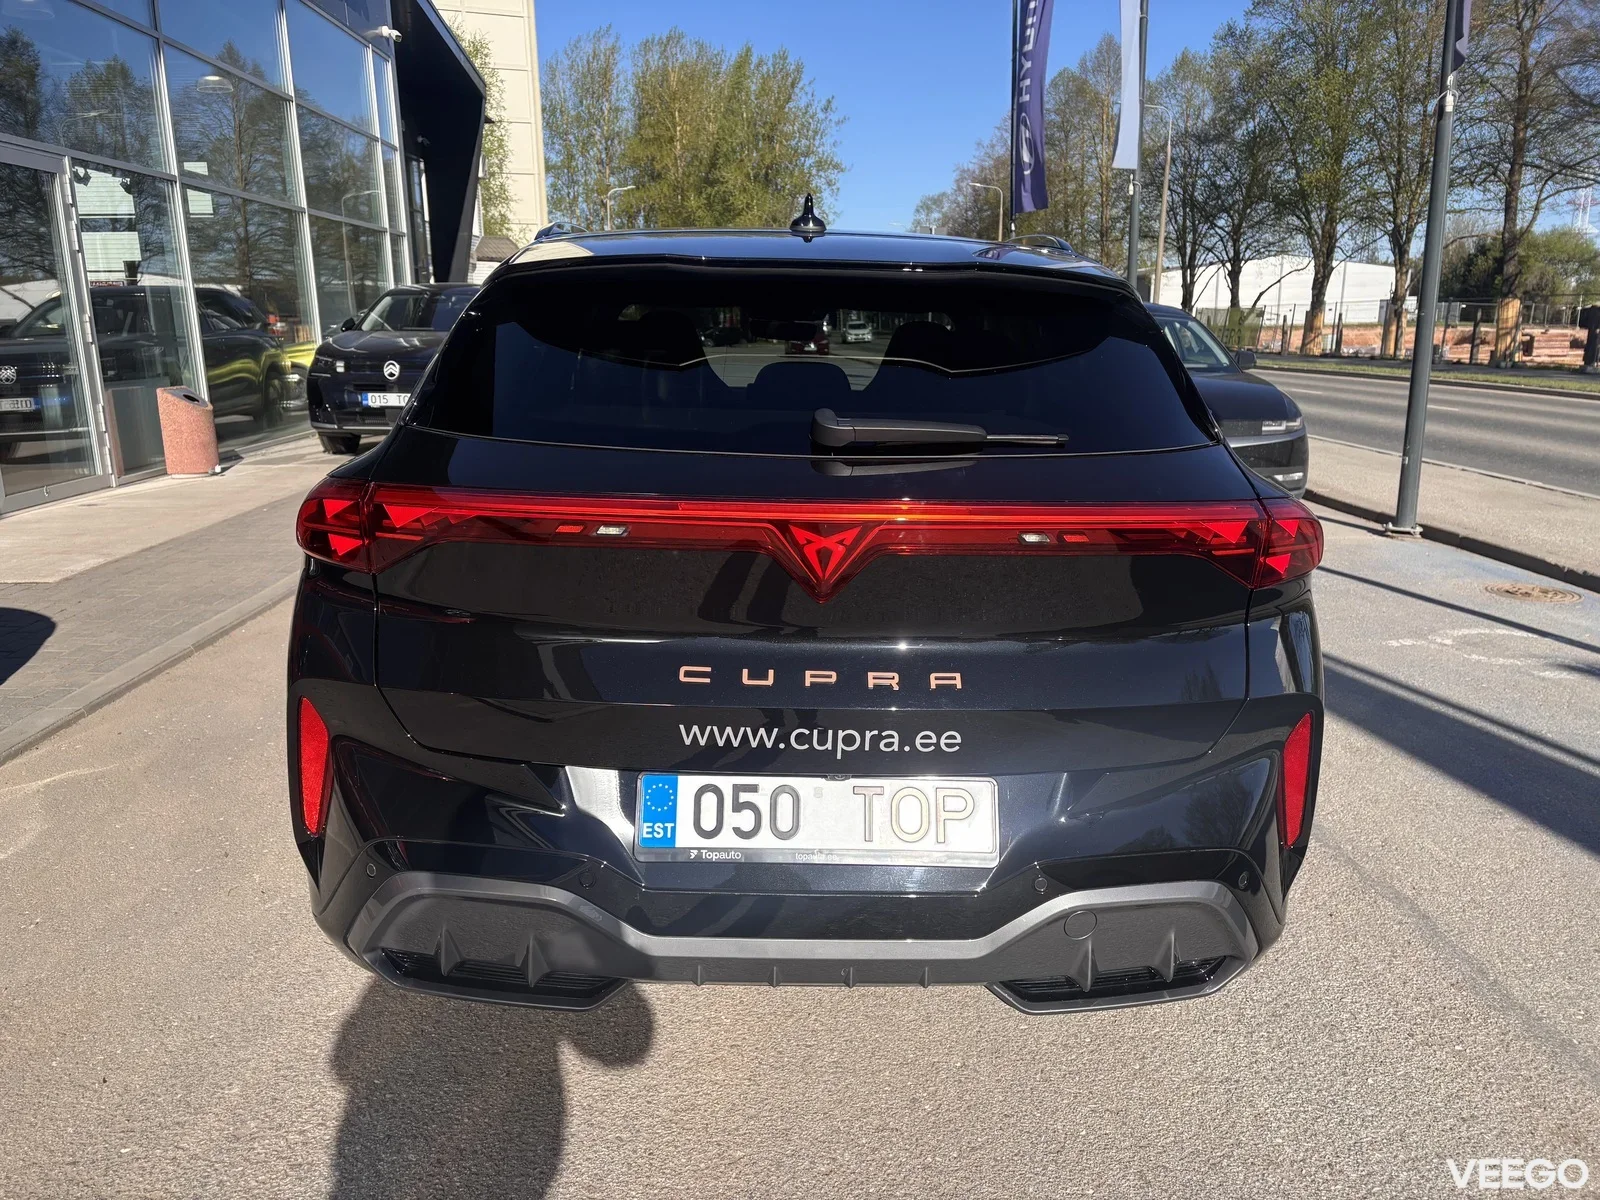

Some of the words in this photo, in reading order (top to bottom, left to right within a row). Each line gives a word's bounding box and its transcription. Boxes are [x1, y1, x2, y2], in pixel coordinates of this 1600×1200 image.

[370, 394, 388, 404] 015
[679, 665, 963, 690] CUPRA
[679, 724, 962, 759] www.cupra.ee
[693, 783, 801, 840] 050
[852, 786, 975, 843] TOP
[642, 823, 675, 838] EST
[700, 849, 742, 861] Topauto
